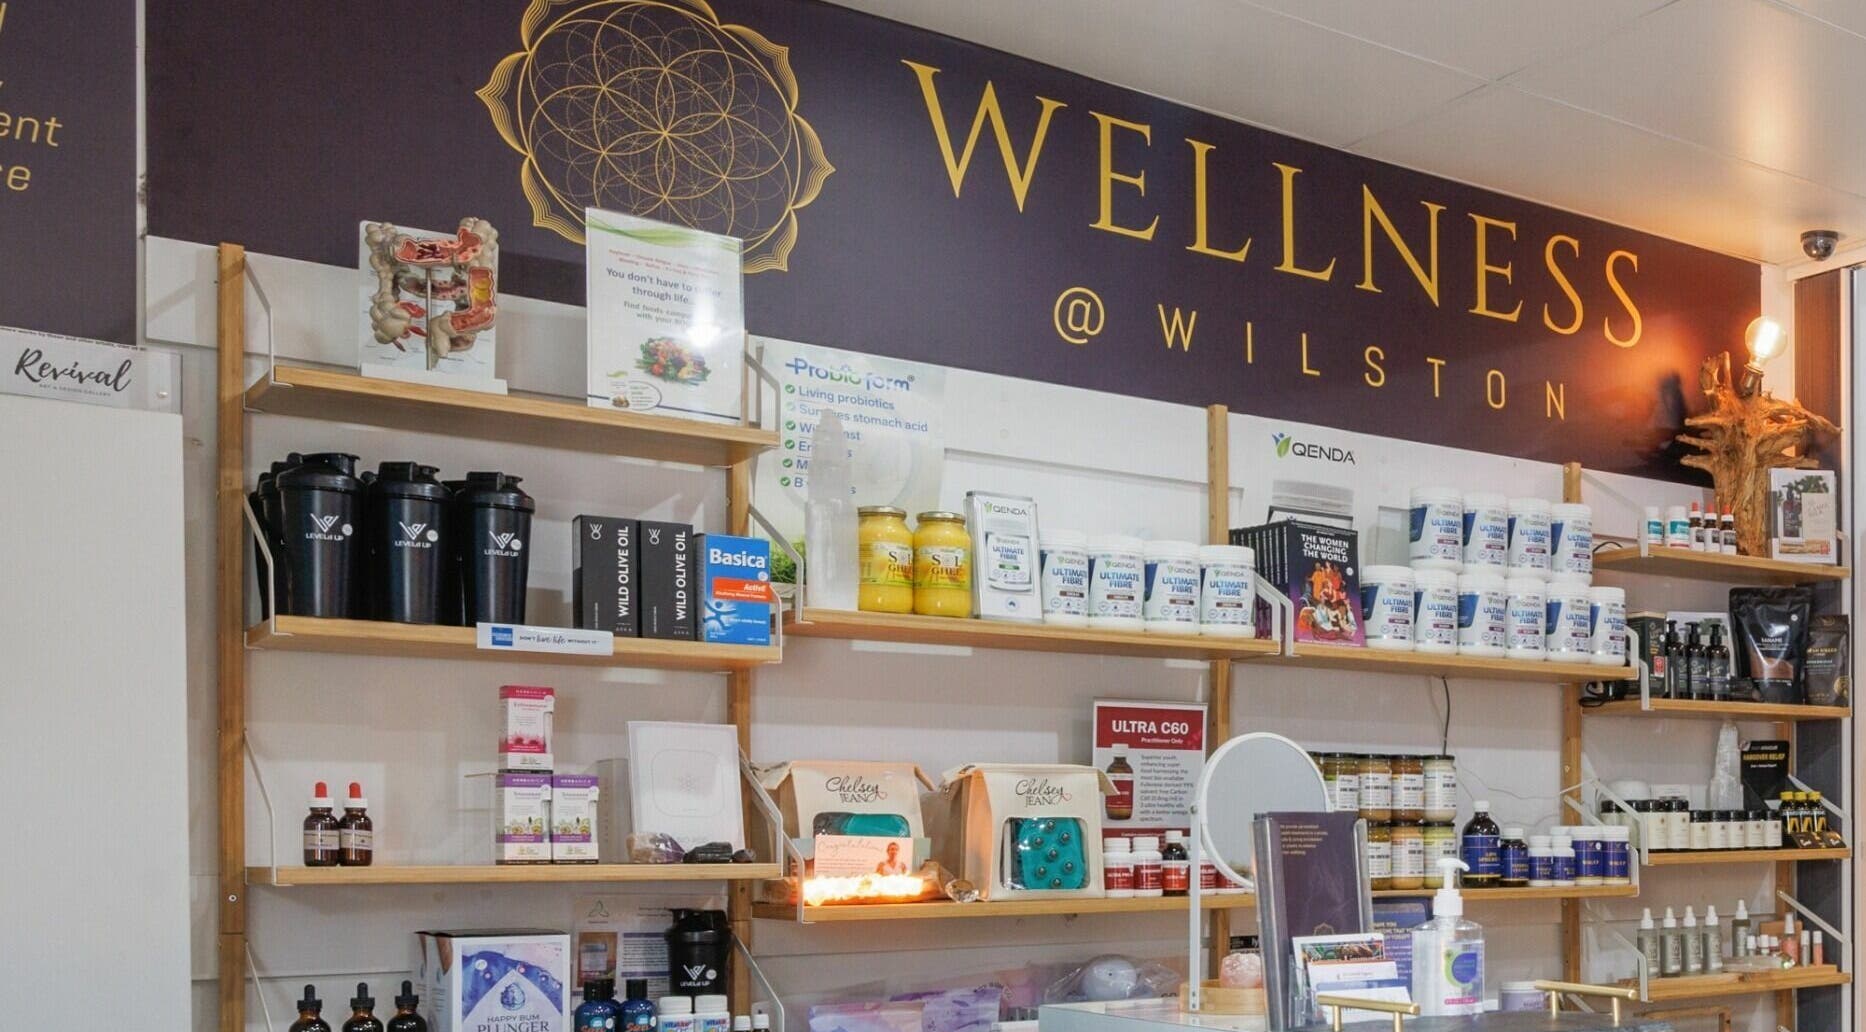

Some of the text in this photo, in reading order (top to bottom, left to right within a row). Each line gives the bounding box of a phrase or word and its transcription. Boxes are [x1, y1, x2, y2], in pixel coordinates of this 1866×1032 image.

[902, 59, 1645, 348] WELLNESS
[606, 267, 625, 279] You
[627, 273, 654, 285] don't
[656, 277, 680, 290] have
[682, 281, 693, 291] to
[632, 285, 672, 302] through
[624, 301, 664, 314] Find foods
[636, 312, 672, 325] with your
[1054, 287, 1566, 420] @ WILSTON
[15, 348, 132, 392] Revival
[799, 386, 895, 411] Living probiotics
[852, 413, 902, 429] stomach
[904, 420, 929, 432] acid
[1292, 442, 1355, 465] QENDA
[993, 506, 1027, 516] QENDA
[618, 526, 629, 548] OIL
[675, 531, 686, 552] OIL
[1301, 533, 1349, 549] THE WOMEN
[993, 546, 1025, 555] ULTIMATE
[1000, 552, 1018, 561] FIBRE
[1303, 542, 1347, 555] CHANGING
[1303, 549, 1348, 563] THE WORLD
[709, 548, 765, 569] Basica
[618, 549, 629, 587] OLIVE
[675, 553, 686, 588] OLIVE
[1062, 577, 1083, 586] FIBRE
[1100, 571, 1139, 582] ULTIMATE
[1109, 580, 1133, 589] FIBRE
[1171, 584, 1193, 594] FIBRE
[1209, 580, 1248, 590] ULTIMATE
[1218, 587, 1241, 597] FIBRE
[618, 588, 629, 618] WILD
[675, 589, 686, 621] WILD
[1519, 616, 1539, 625] FIBRE
[1112, 719, 1189, 735] ULTRA C60
[825, 776, 881, 797] Chelsey
[1015, 779, 1065, 800] Chelsey
[487, 1015, 518, 1023] HAPPY
